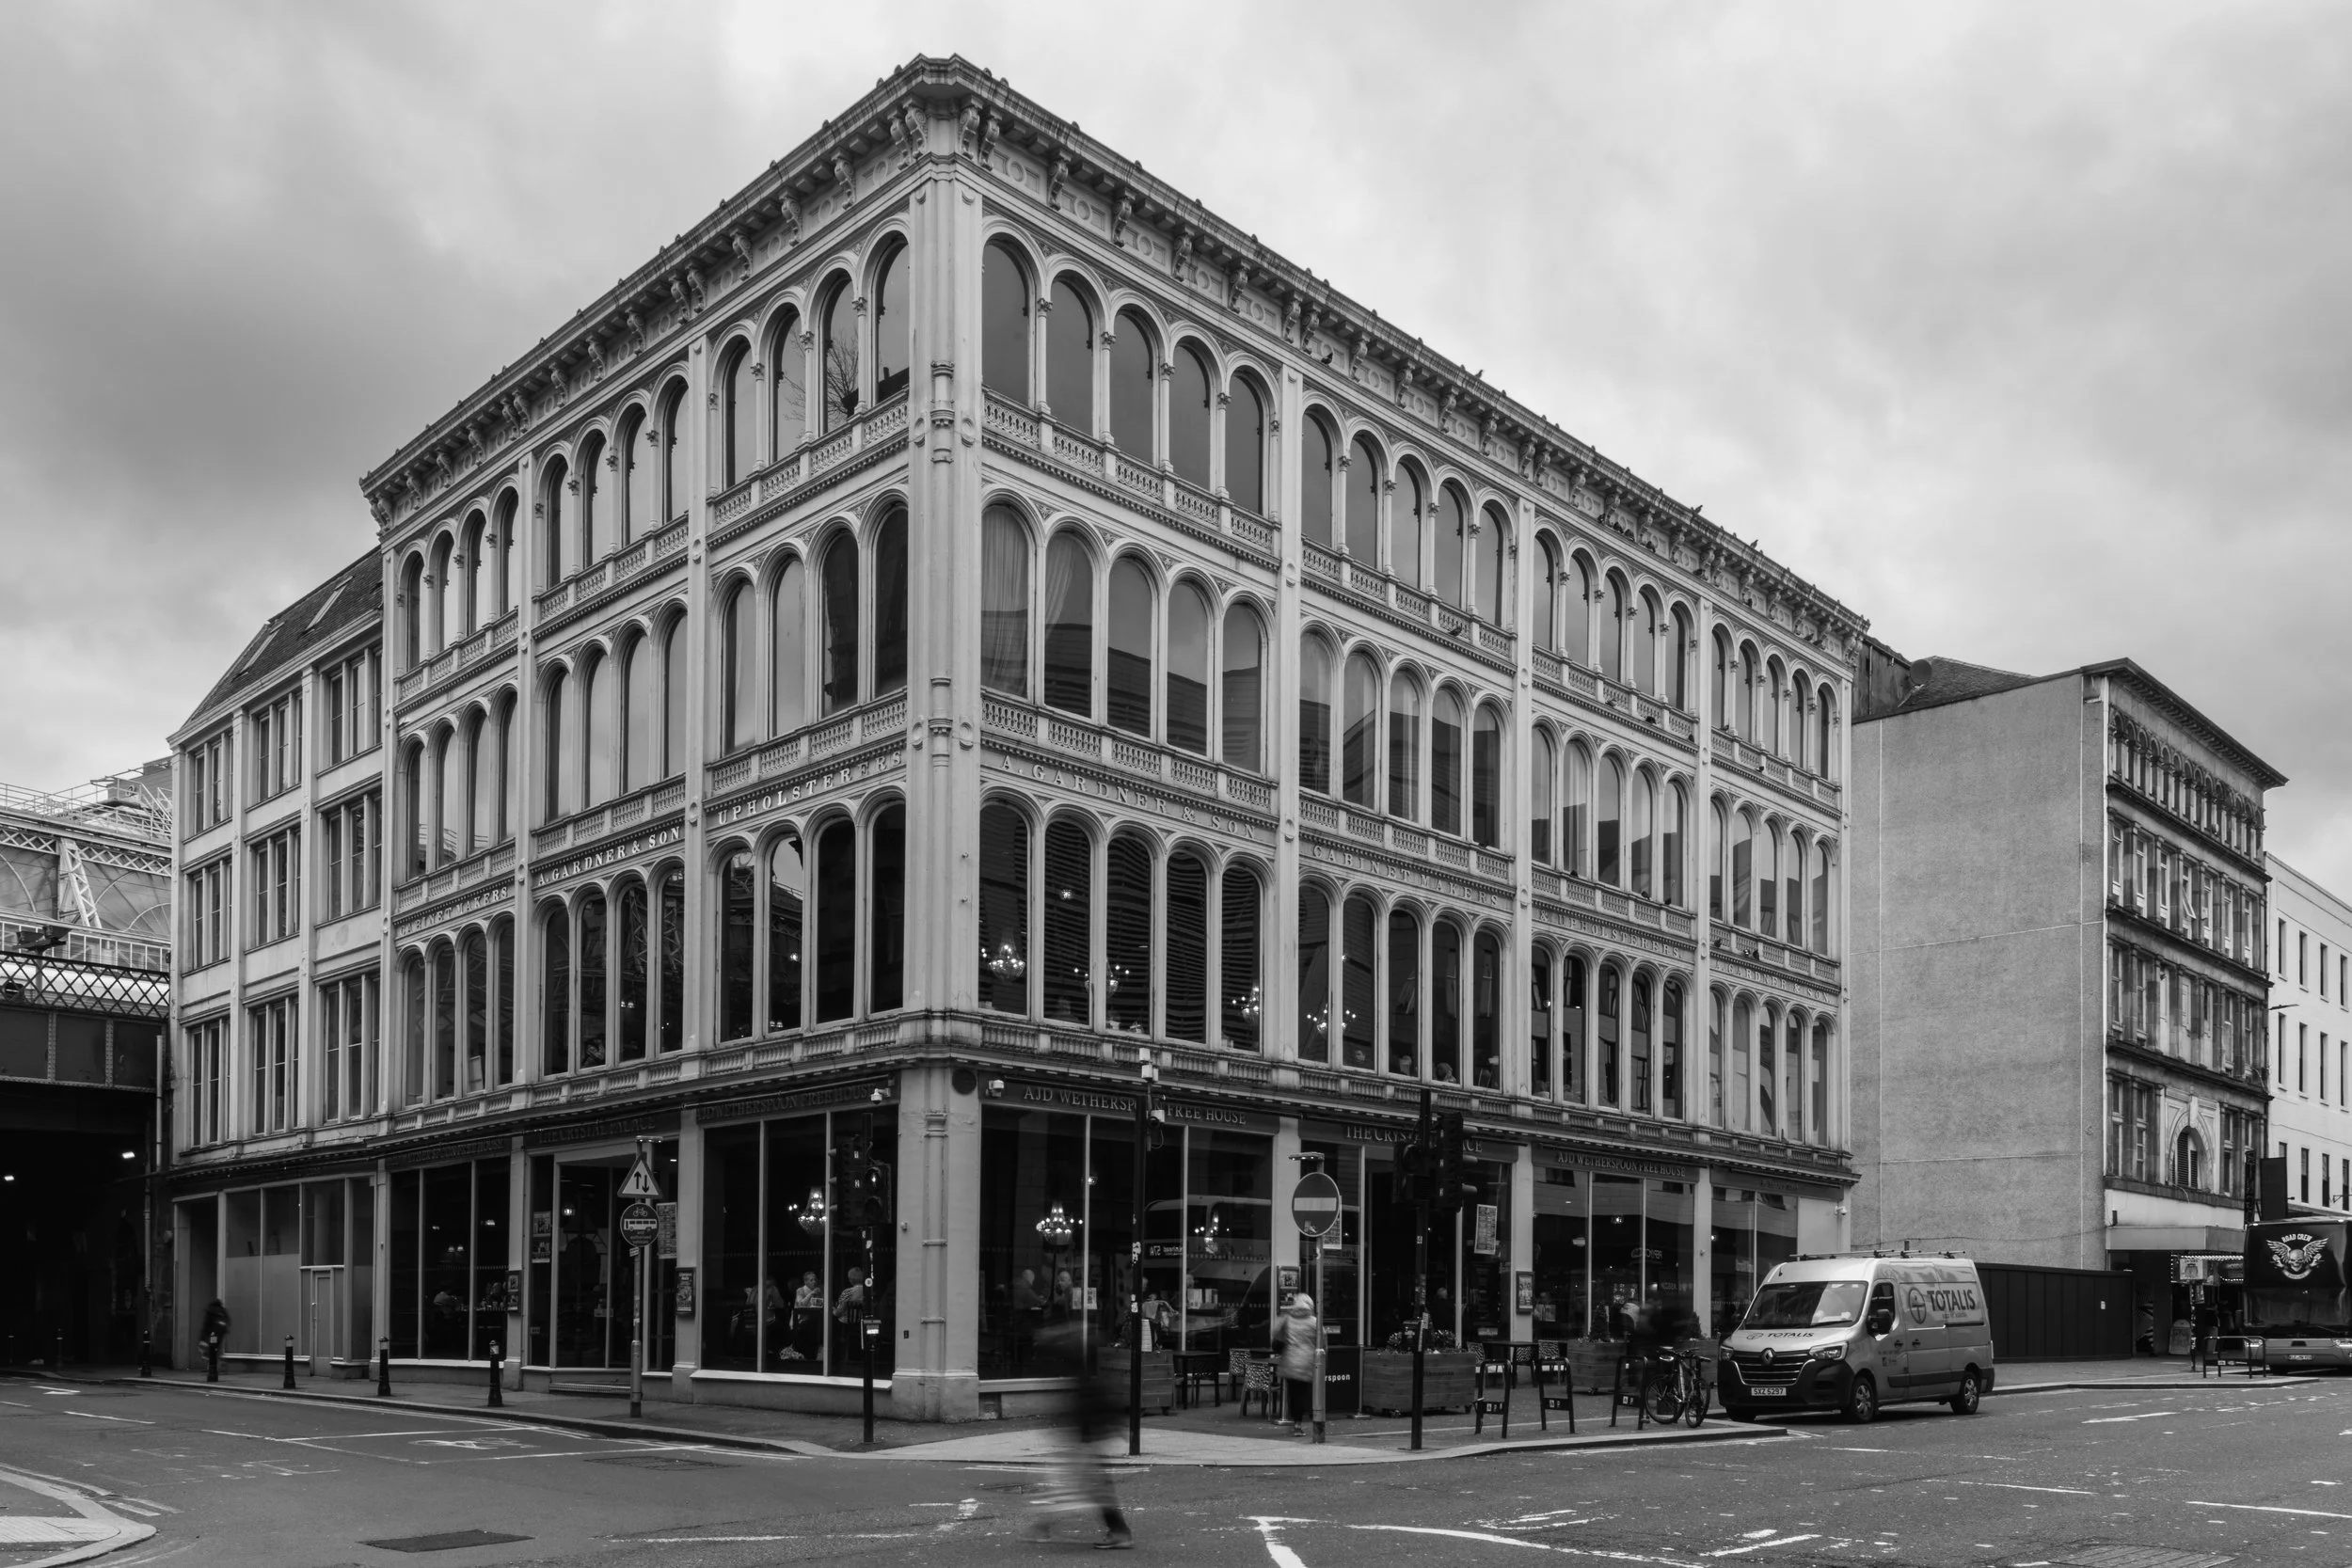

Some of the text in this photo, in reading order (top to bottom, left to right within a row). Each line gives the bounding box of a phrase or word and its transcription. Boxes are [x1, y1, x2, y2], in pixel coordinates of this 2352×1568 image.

[718, 752, 902, 825] UPHOLSTERERS
[1183, 807, 1195, 821] &
[1212, 816, 1256, 839] SON
[631, 840, 640, 854] &
[648, 827, 680, 848] SON
[1313, 846, 1498, 906] CABINET MAKERS
[400, 887, 507, 936] CABINET MAKERS
[1540, 911, 1549, 921] &
[1793, 984, 1800, 992] &
[1024, 1087, 1053, 1102] AJD
[1168, 1104, 1201, 1120] FREE
[1206, 1110, 1248, 1125] HOUSE
[1345, 1125, 1372, 1140] THE
[1558, 1152, 1686, 1177] AJD WETHERSPOON FREE HOUSE
[1927, 1289, 1976, 1312] TOTALIS
[1325, 1374, 1351, 1383] rspoon
